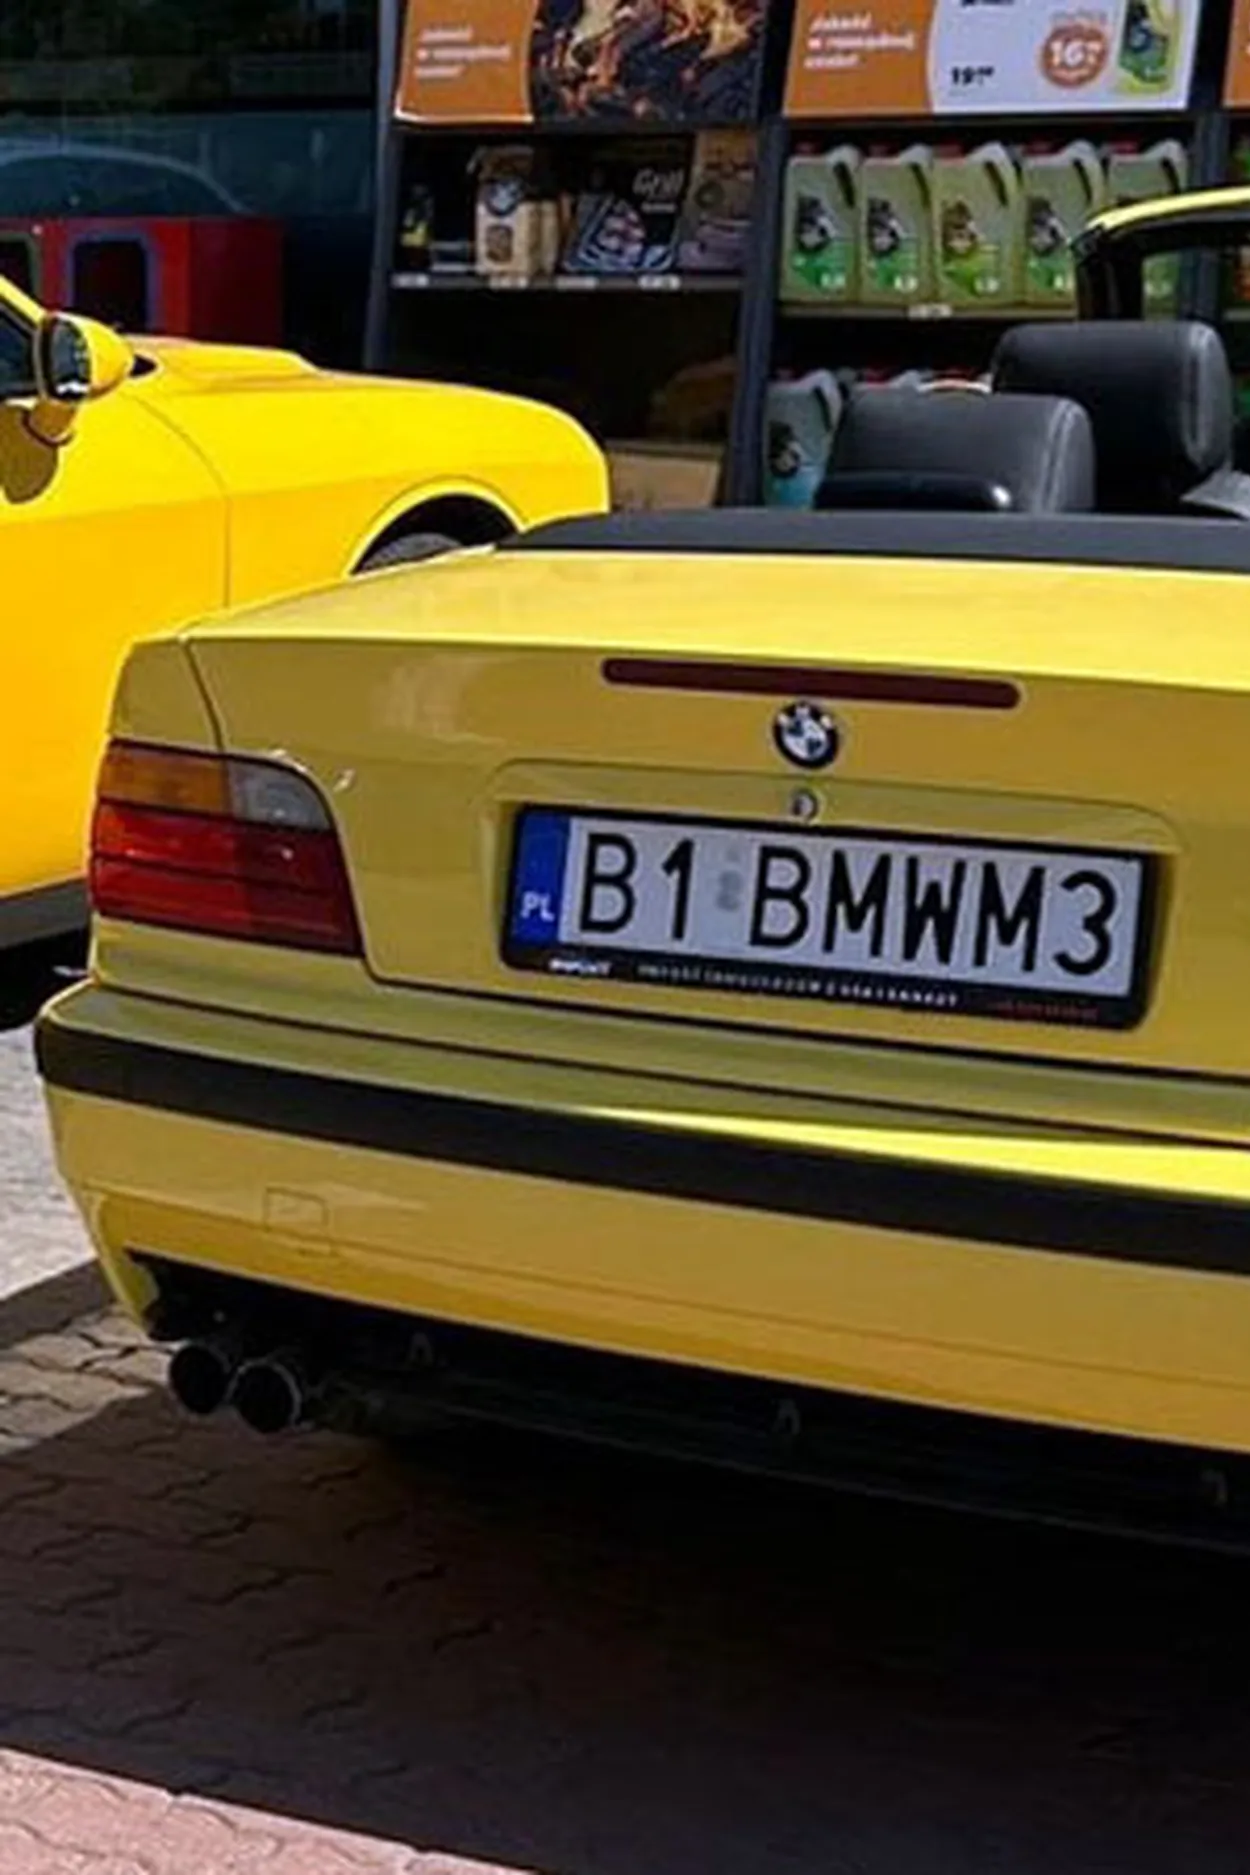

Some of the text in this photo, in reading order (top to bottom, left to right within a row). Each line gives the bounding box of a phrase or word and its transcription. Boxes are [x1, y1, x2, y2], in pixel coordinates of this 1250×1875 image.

[519, 890, 556, 922] PL
[578, 832, 1118, 977] B1 BMWM3
